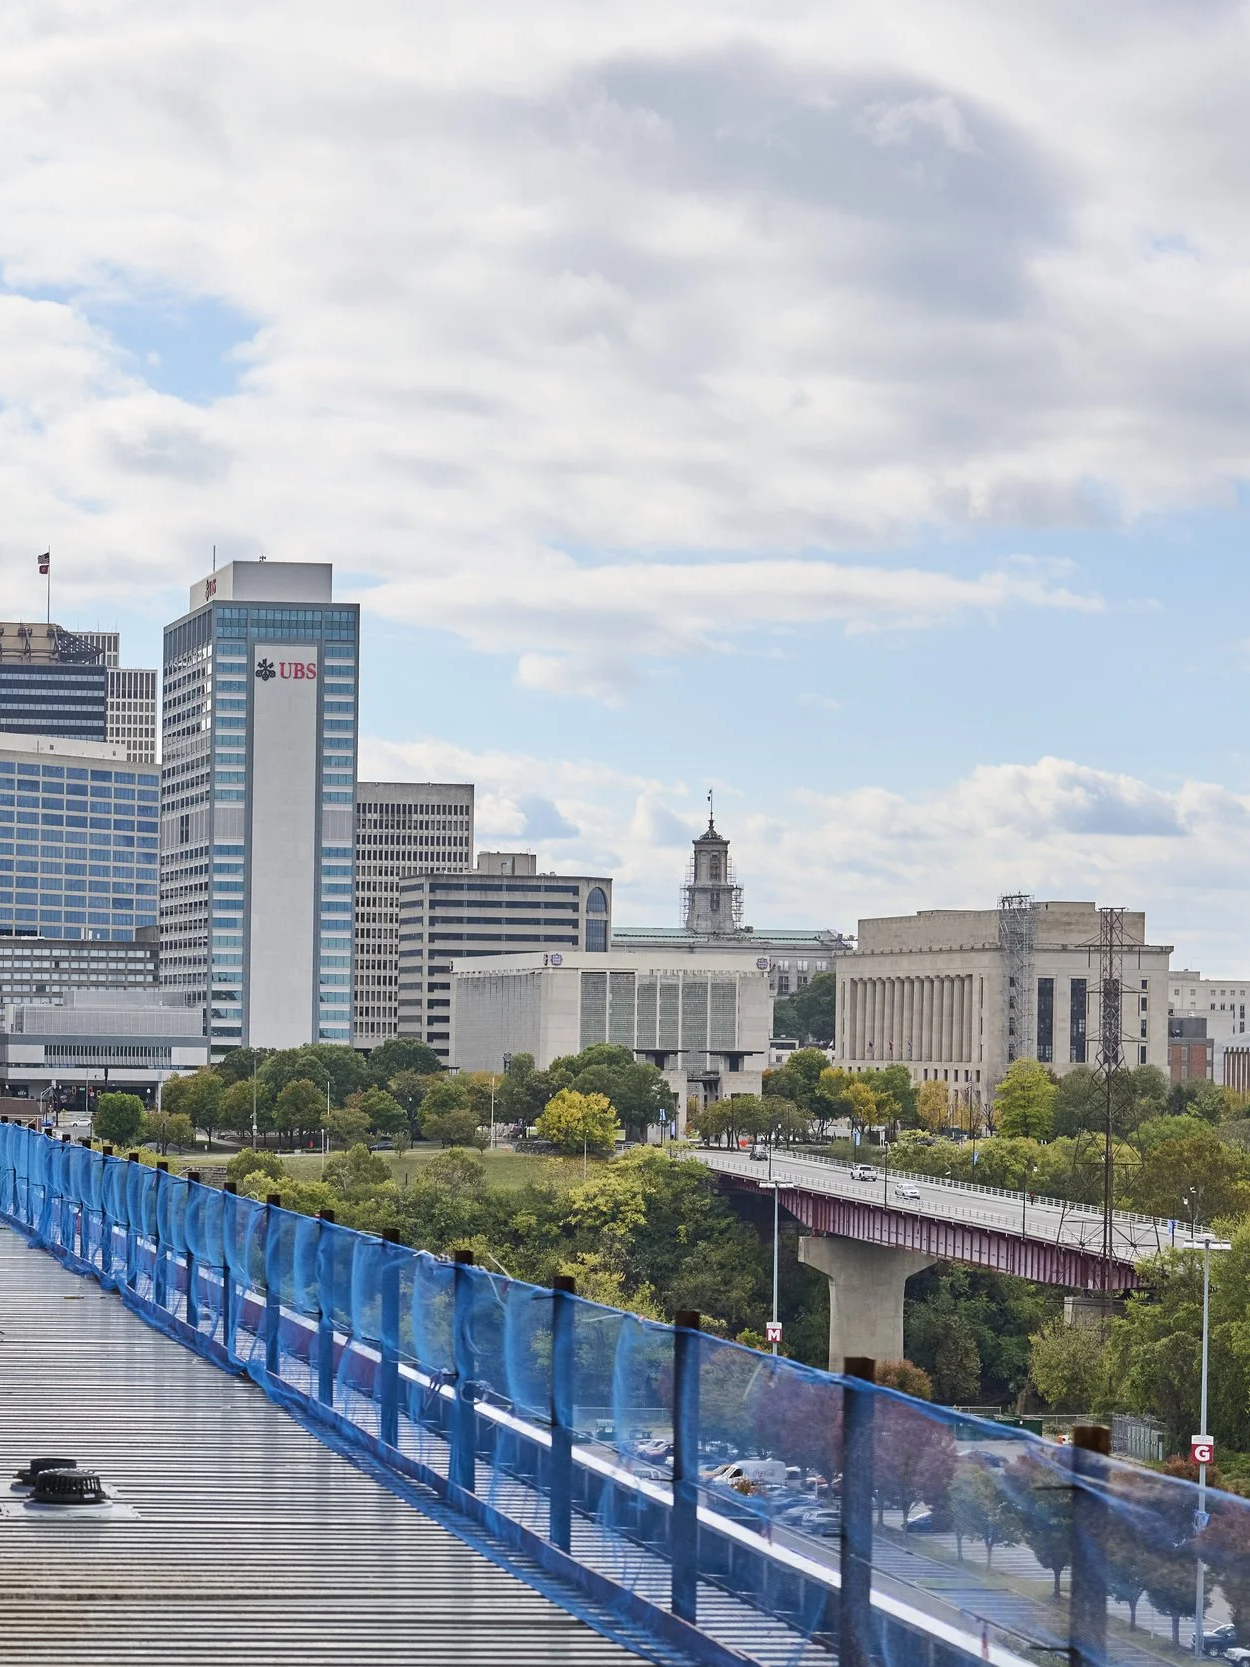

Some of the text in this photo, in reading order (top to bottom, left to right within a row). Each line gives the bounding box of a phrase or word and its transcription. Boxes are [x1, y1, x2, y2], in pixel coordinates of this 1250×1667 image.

[279, 662, 317, 680] UBS
[767, 1329, 781, 1342] M
[1194, 1445, 1210, 1462] G
